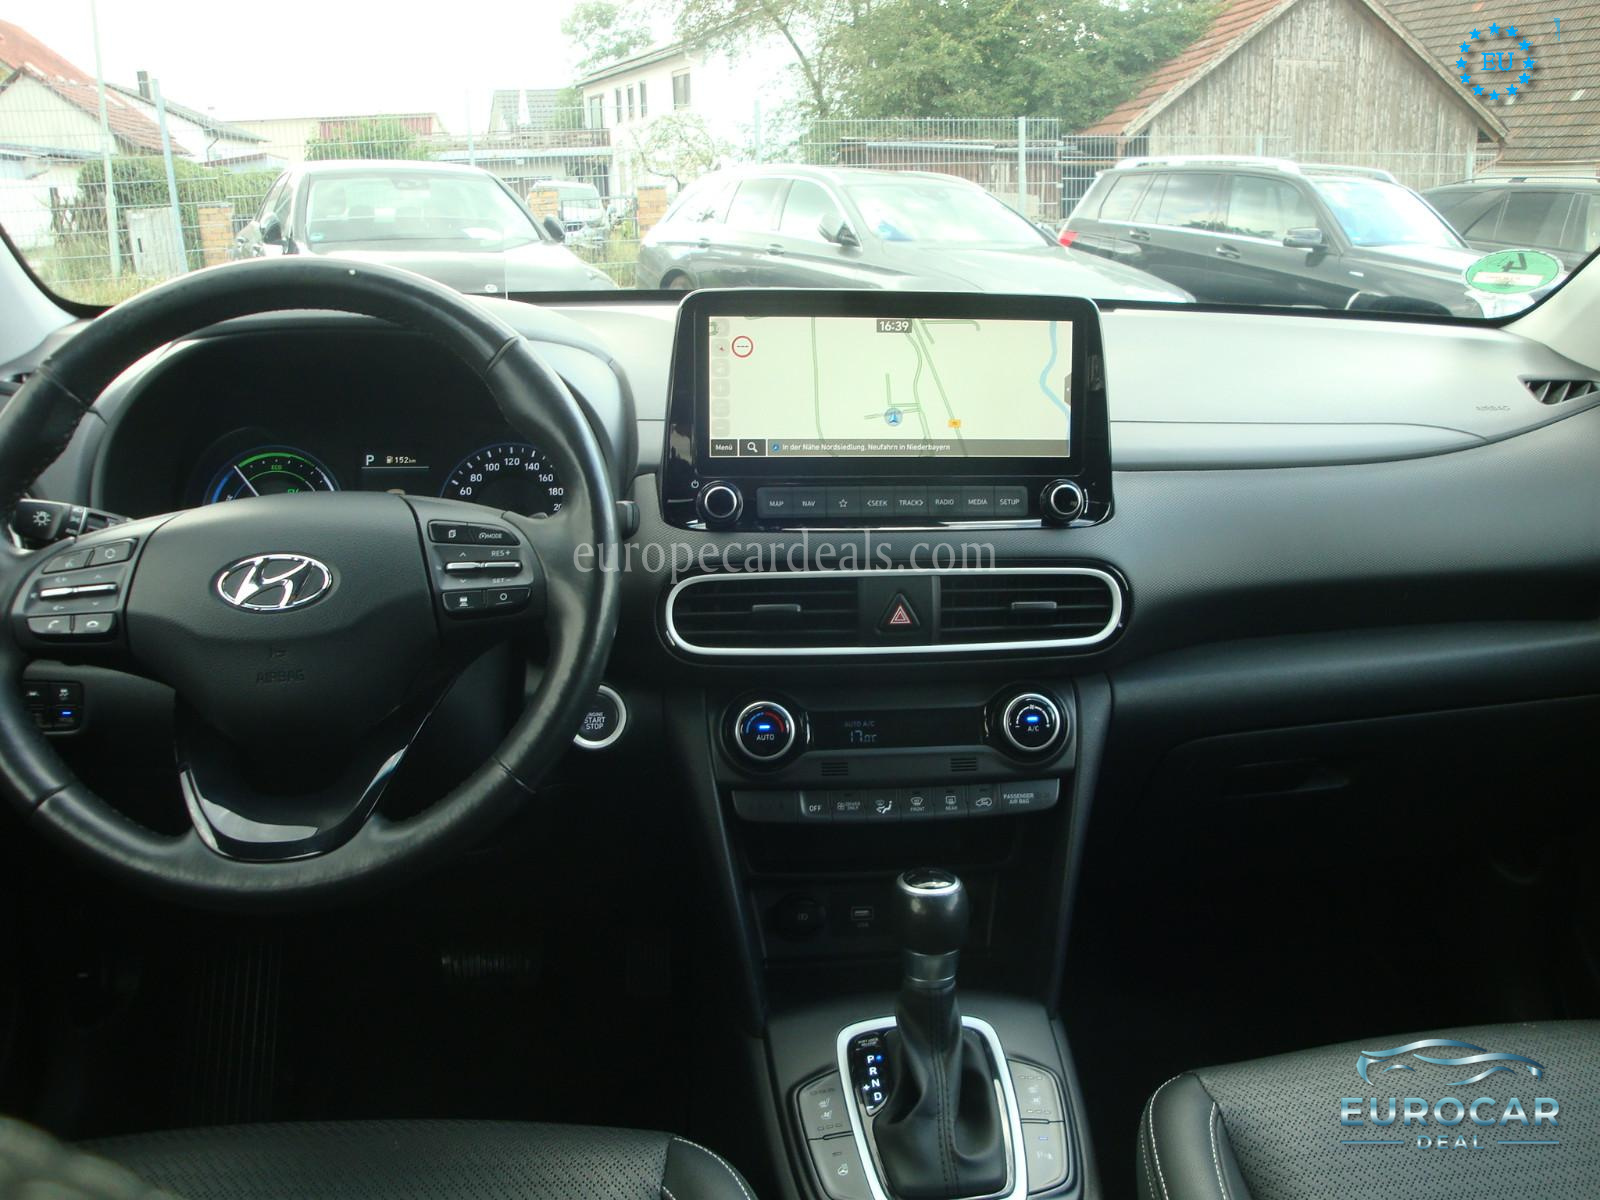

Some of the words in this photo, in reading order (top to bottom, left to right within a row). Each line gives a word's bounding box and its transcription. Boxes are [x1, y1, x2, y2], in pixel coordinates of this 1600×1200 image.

[880, 321, 909, 331] 16:39
[715, 443, 733, 451] Menü
[802, 443, 819, 451] Nähe
[868, 443, 898, 451] Neufahrn
[906, 443, 951, 453] Niederbayern
[366, 455, 375, 466] P
[504, 457, 520, 466] 120
[484, 463, 500, 471] 100
[524, 462, 540, 471] 140
[470, 474, 482, 482] 80
[538, 473, 554, 482] 160
[460, 487, 472, 496] 60
[548, 487, 564, 496] 180
[584, 716, 606, 724] START
[756, 733, 776, 741] AUTO
[809, 804, 821, 812] OFF
[866, 1055, 875, 1064] P
[869, 1067, 877, 1076] R
[871, 1078, 880, 1088] N
[873, 1091, 883, 1101] D
